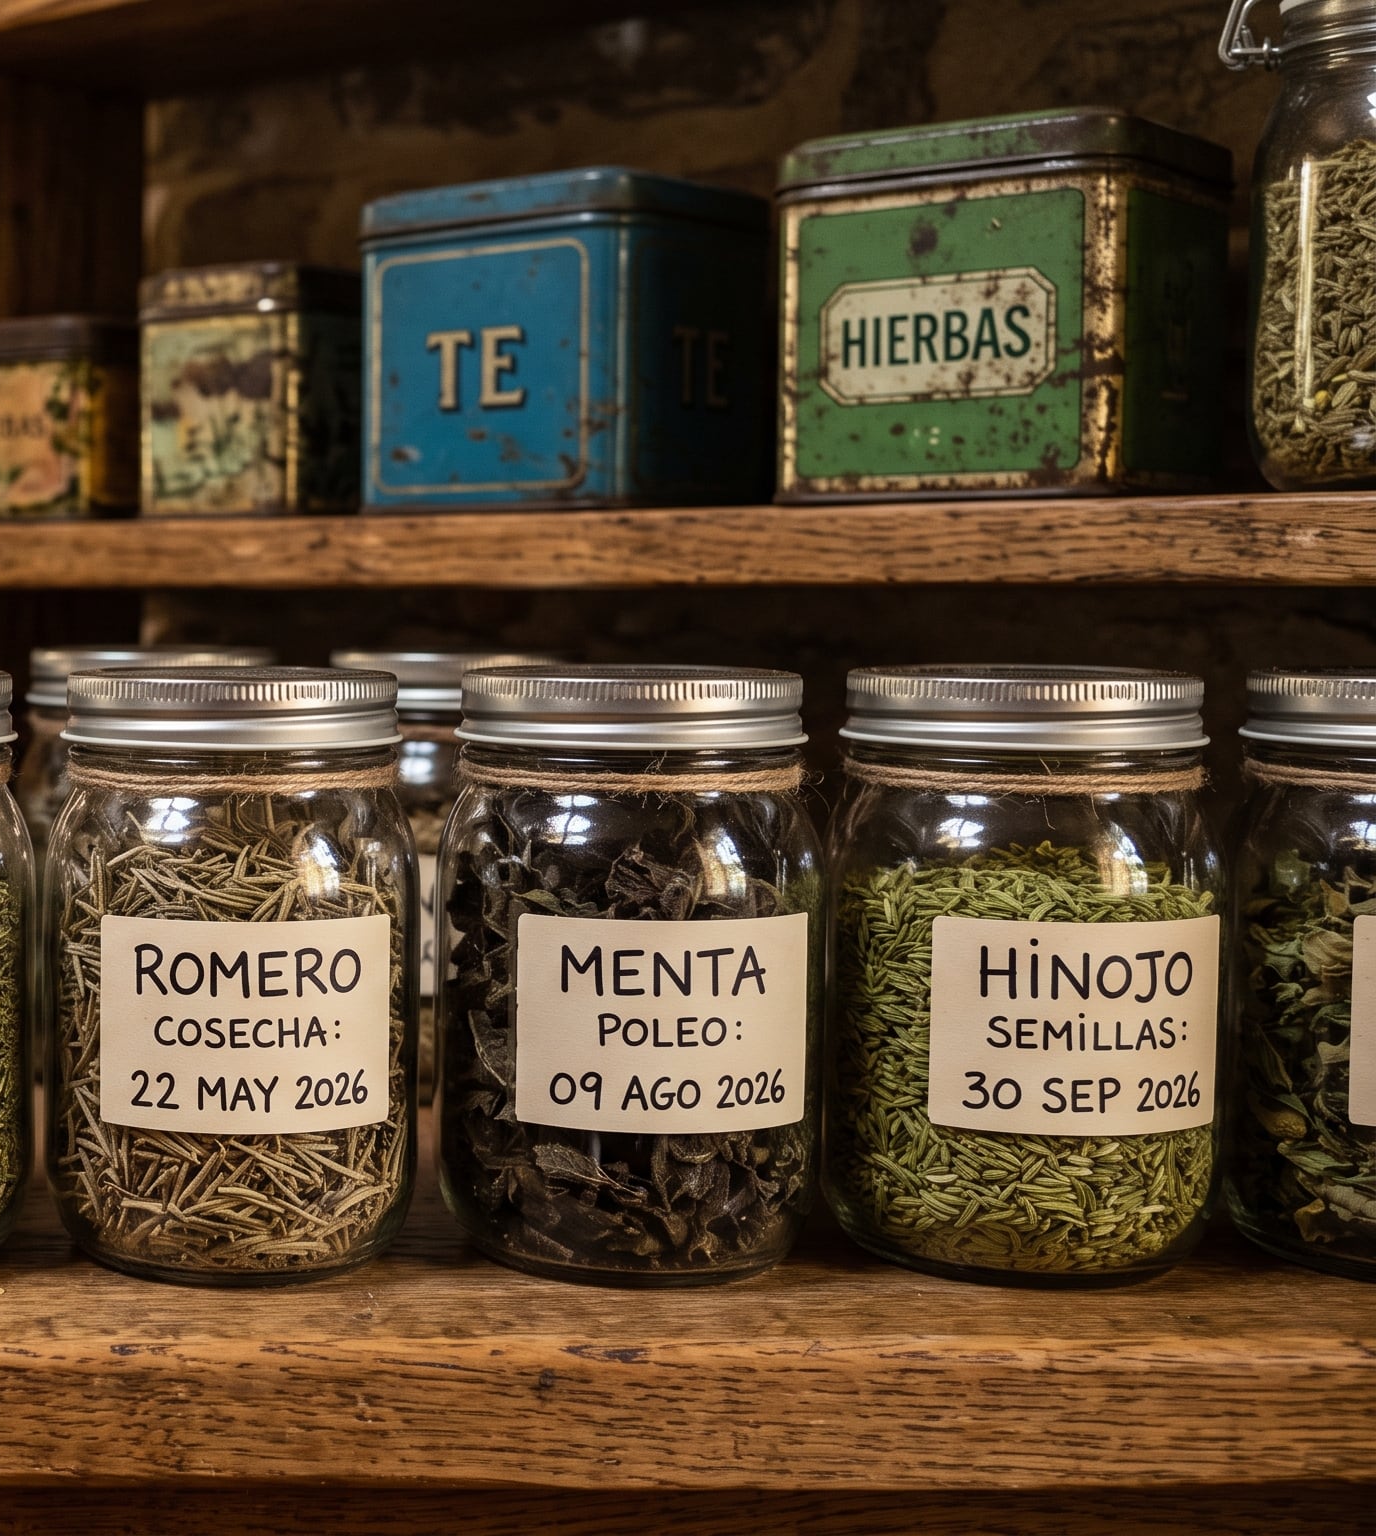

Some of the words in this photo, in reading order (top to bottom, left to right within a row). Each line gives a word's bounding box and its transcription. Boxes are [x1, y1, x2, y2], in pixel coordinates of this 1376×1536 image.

[841, 302, 1032, 370] HIERBAS
[426, 325, 524, 410] TE
[671, 324, 730, 408] TE
[134, 943, 362, 999] ROMERO
[560, 944, 766, 998] MENTA
[153, 1015, 341, 1050] COSECHA:
[597, 1012, 742, 1048] POLEO:
[130, 1069, 180, 1110] 22
[197, 1075, 279, 1114] MAY
[294, 1068, 368, 1110] 2026
[549, 1071, 603, 1111] 09
[620, 1075, 701, 1112] AGO
[716, 1068, 786, 1109] 2026
[961, 1071, 1022, 1110] 30
[1041, 1077, 1122, 1114] SEP
[1136, 1070, 1201, 1113] 2026
